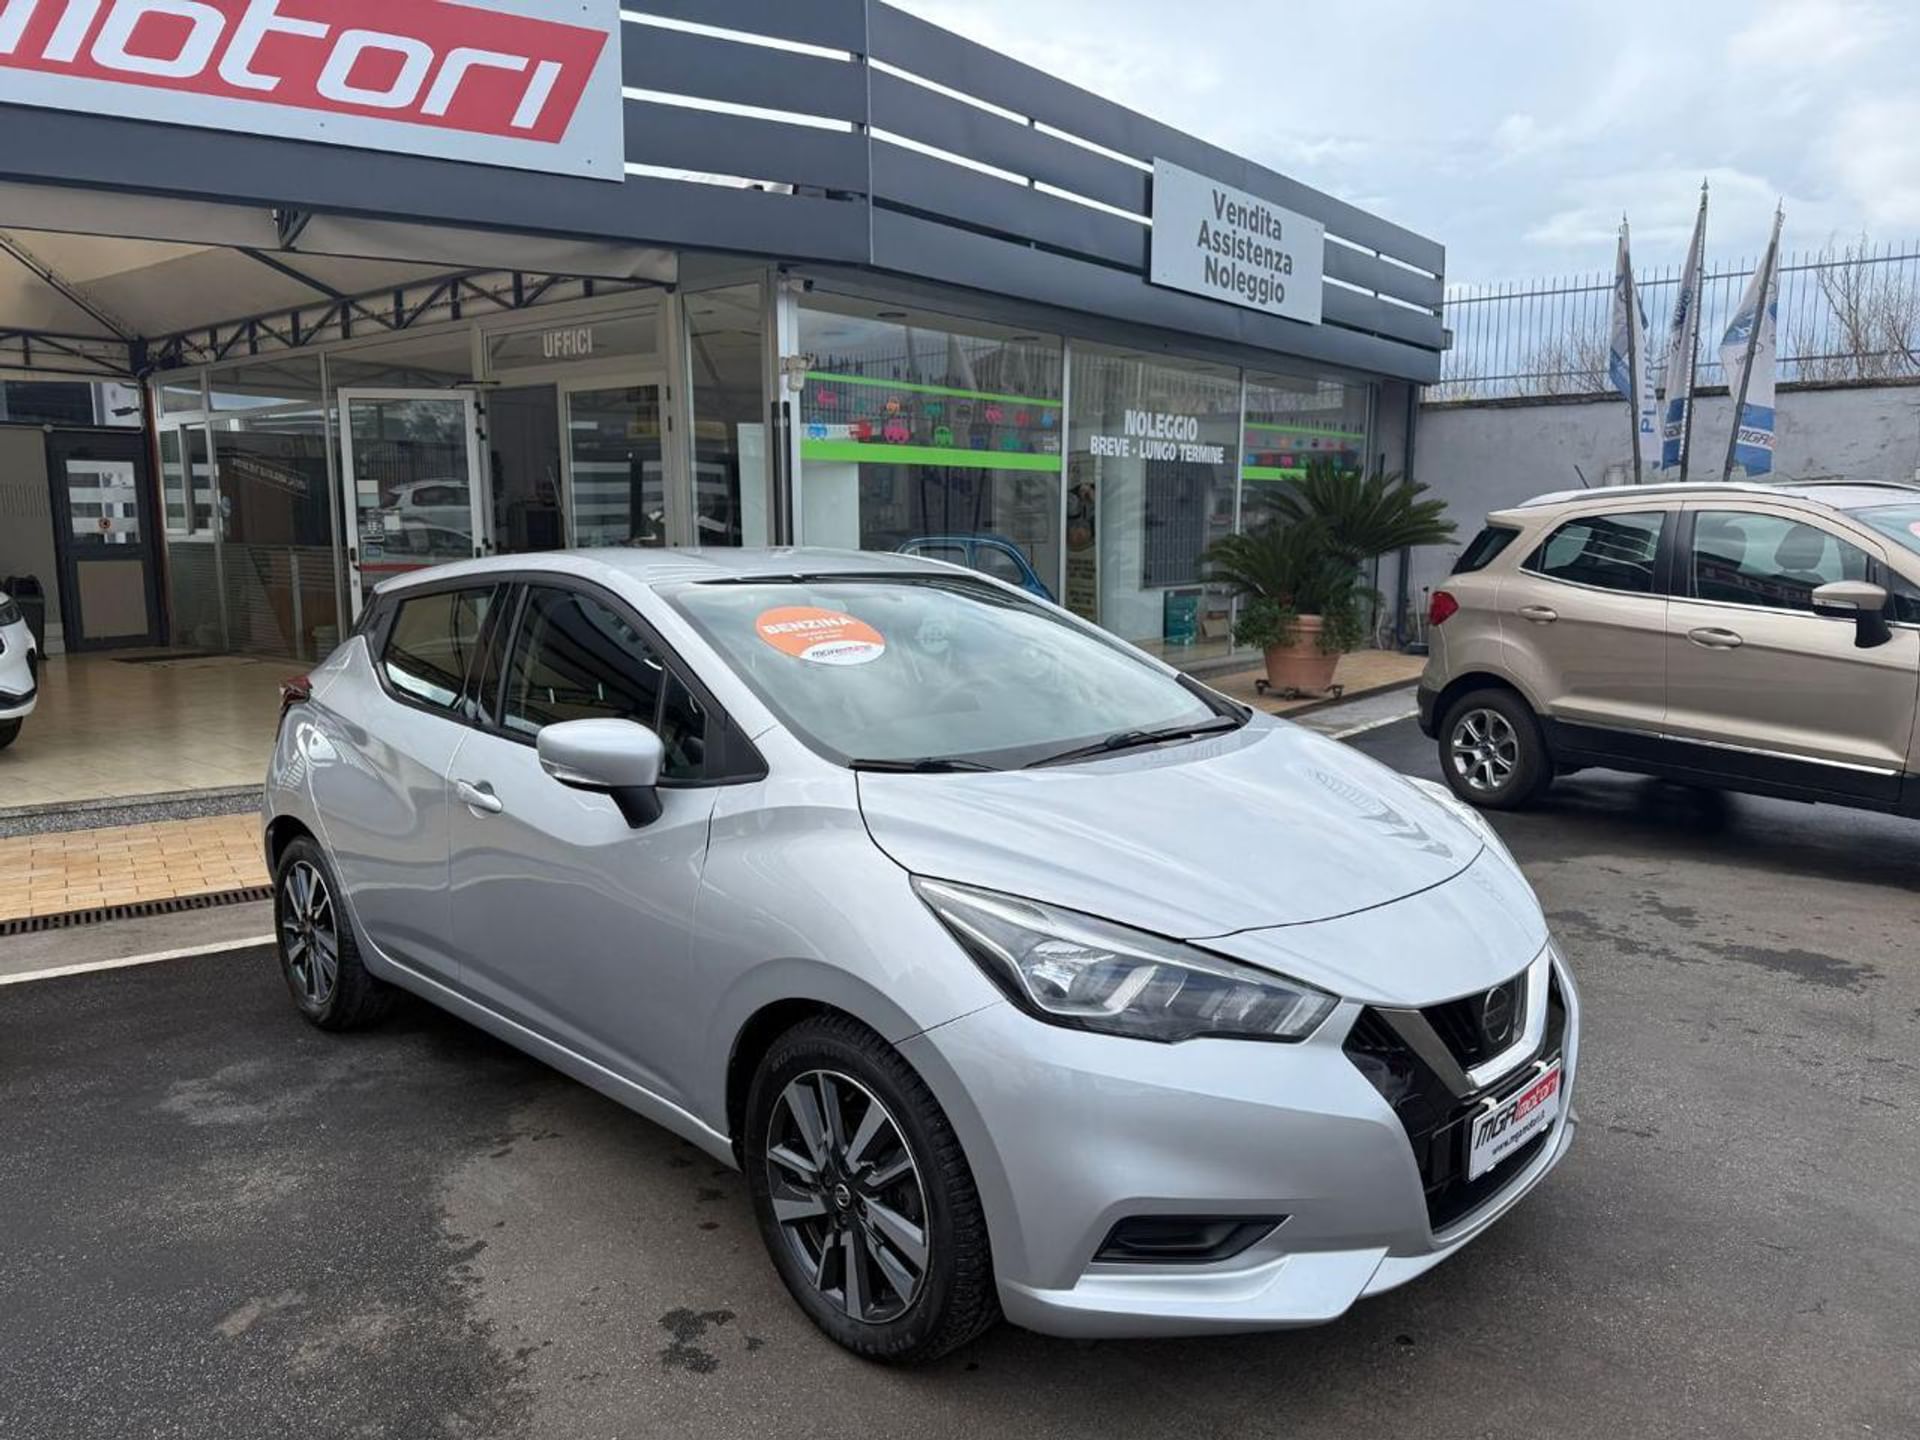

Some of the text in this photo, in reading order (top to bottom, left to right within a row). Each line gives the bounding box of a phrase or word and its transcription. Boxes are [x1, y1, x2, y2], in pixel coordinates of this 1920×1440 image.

[1212, 188, 1282, 241] Vendita
[1197, 219, 1293, 276] Assistenza
[1204, 254, 1285, 305] Noleggio
[543, 327, 593, 357] UFFICI
[1124, 409, 1199, 441] NOLEGGIO
[1090, 435, 1129, 457] BREVE
[1139, 440, 1177, 461] LUNGO
[1179, 443, 1224, 464] TERMINE
